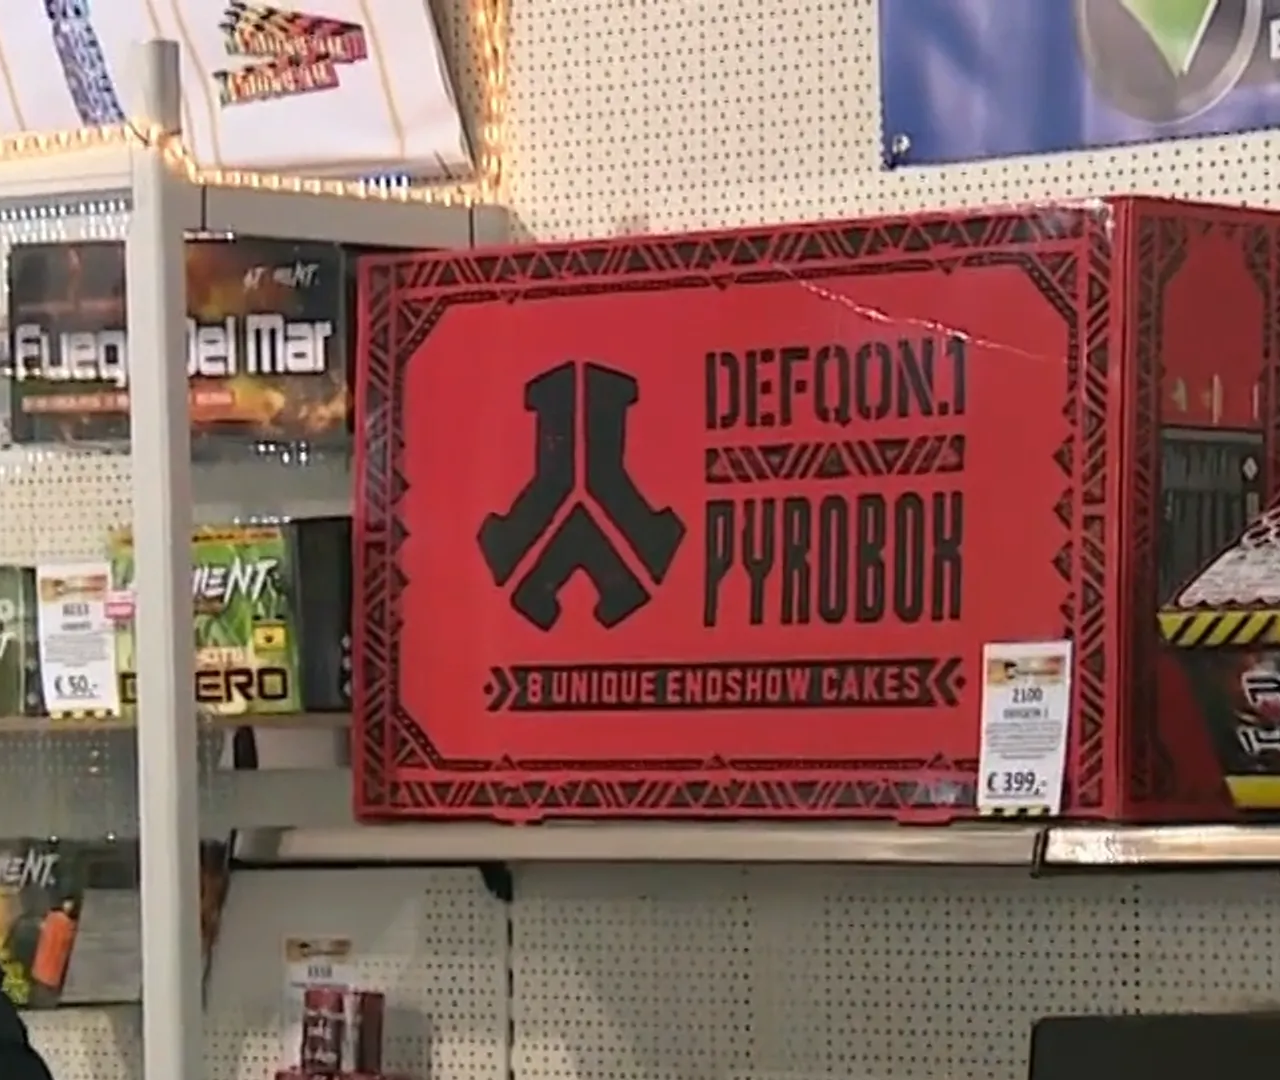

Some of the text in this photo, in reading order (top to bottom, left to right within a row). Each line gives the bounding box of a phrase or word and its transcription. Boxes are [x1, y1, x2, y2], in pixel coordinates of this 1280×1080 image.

[245, 313, 333, 374] Mar
[702, 491, 965, 628] PYROBOX
[551, 670, 657, 704] UNIQUE
[665, 667, 811, 703] ENDSHOW
[821, 665, 919, 702] CAKES
